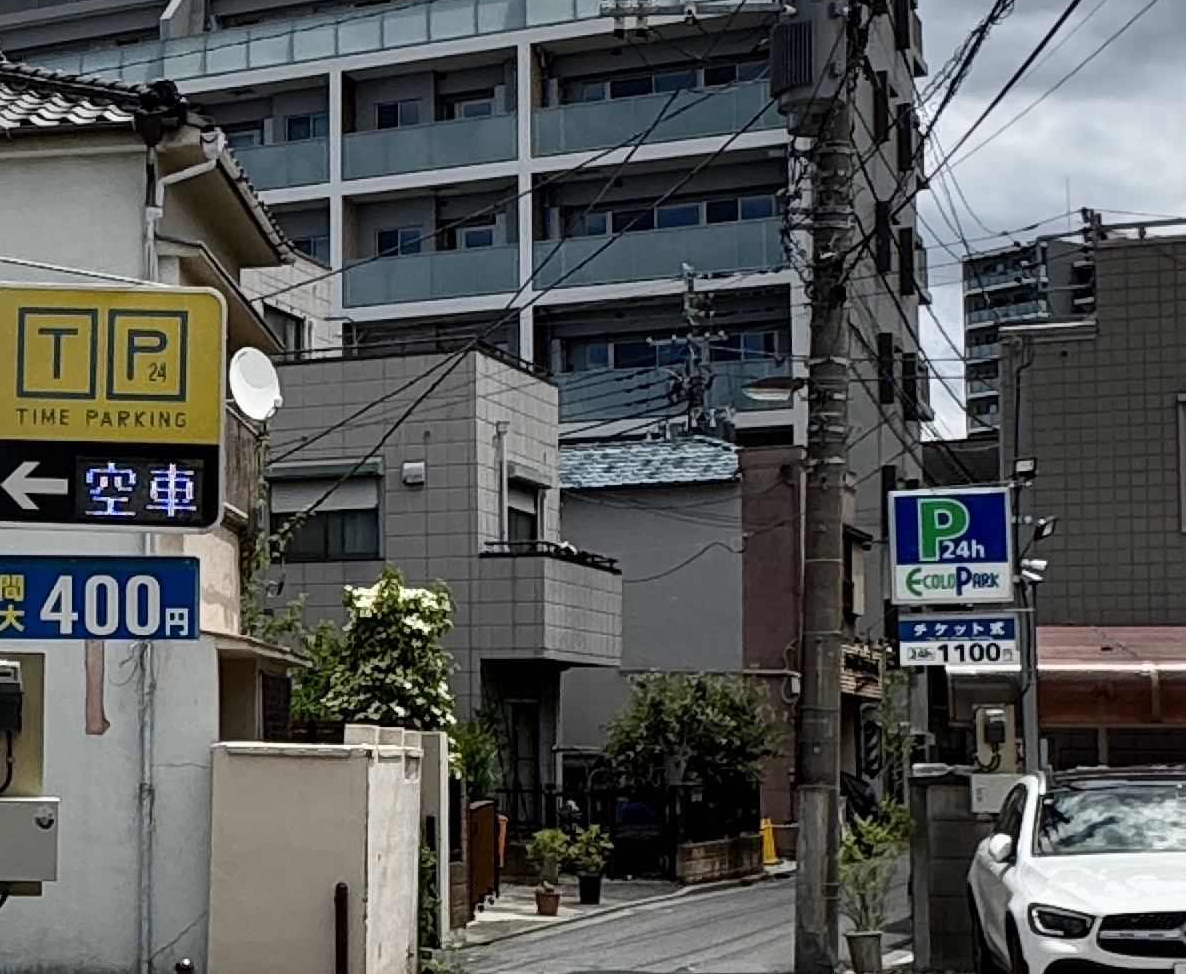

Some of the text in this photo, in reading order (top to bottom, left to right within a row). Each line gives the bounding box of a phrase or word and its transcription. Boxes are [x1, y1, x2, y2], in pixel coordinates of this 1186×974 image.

[148, 362, 167, 382] 24
[16, 408, 187, 428] TIME PARKING
[85, 462, 197, 517] 空車
[917, 498, 970, 562] P
[942, 539, 985, 559] 24h
[913, 621, 1005, 637] チケット式
